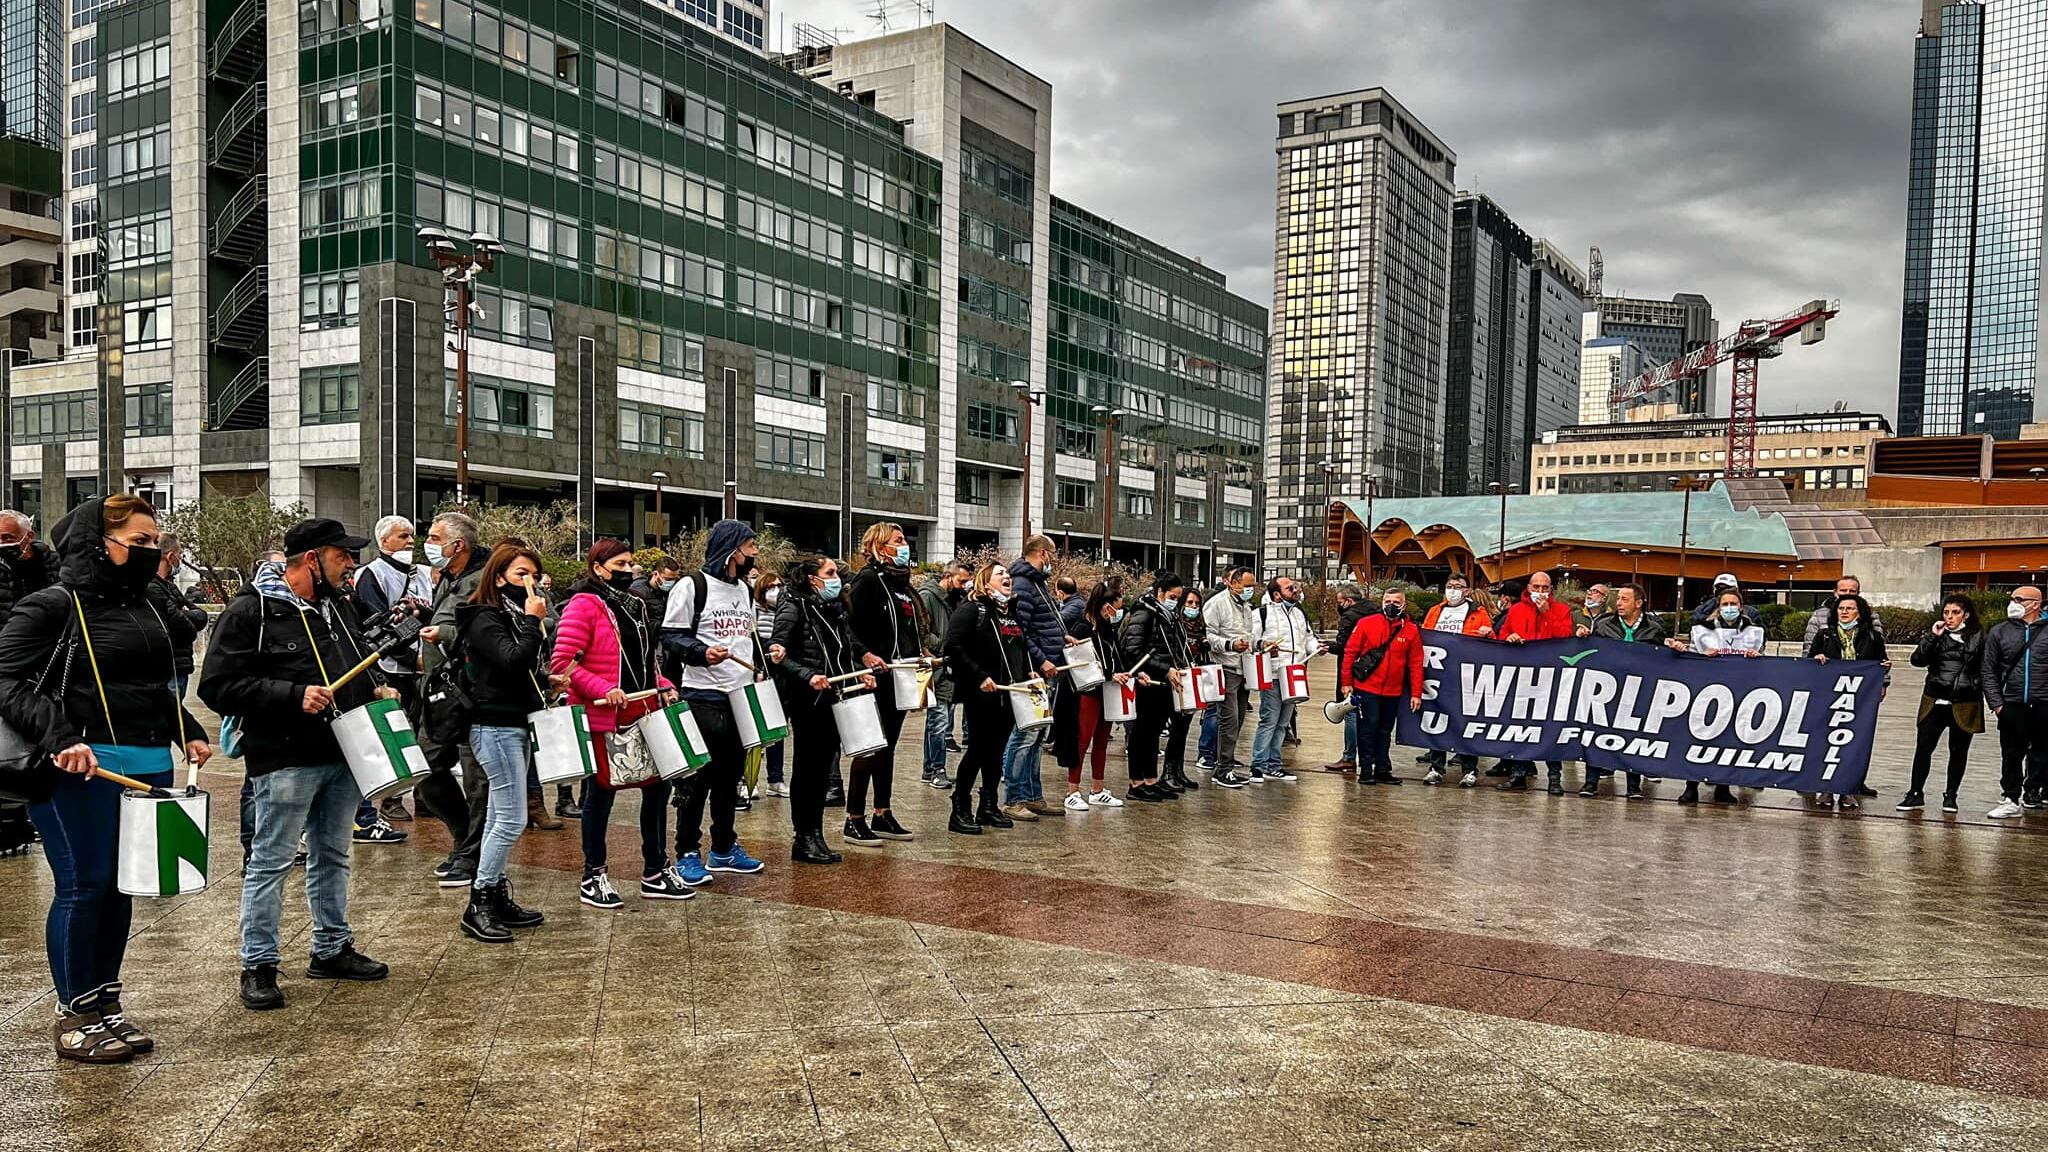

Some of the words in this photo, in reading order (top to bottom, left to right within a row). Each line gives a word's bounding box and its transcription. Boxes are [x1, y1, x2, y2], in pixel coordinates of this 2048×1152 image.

[1460, 662, 1811, 748] WHIRLPOOL
[1462, 722, 1542, 743] FIM
[1556, 727, 1670, 759] FIOM
[1685, 745, 1805, 772] UILM
